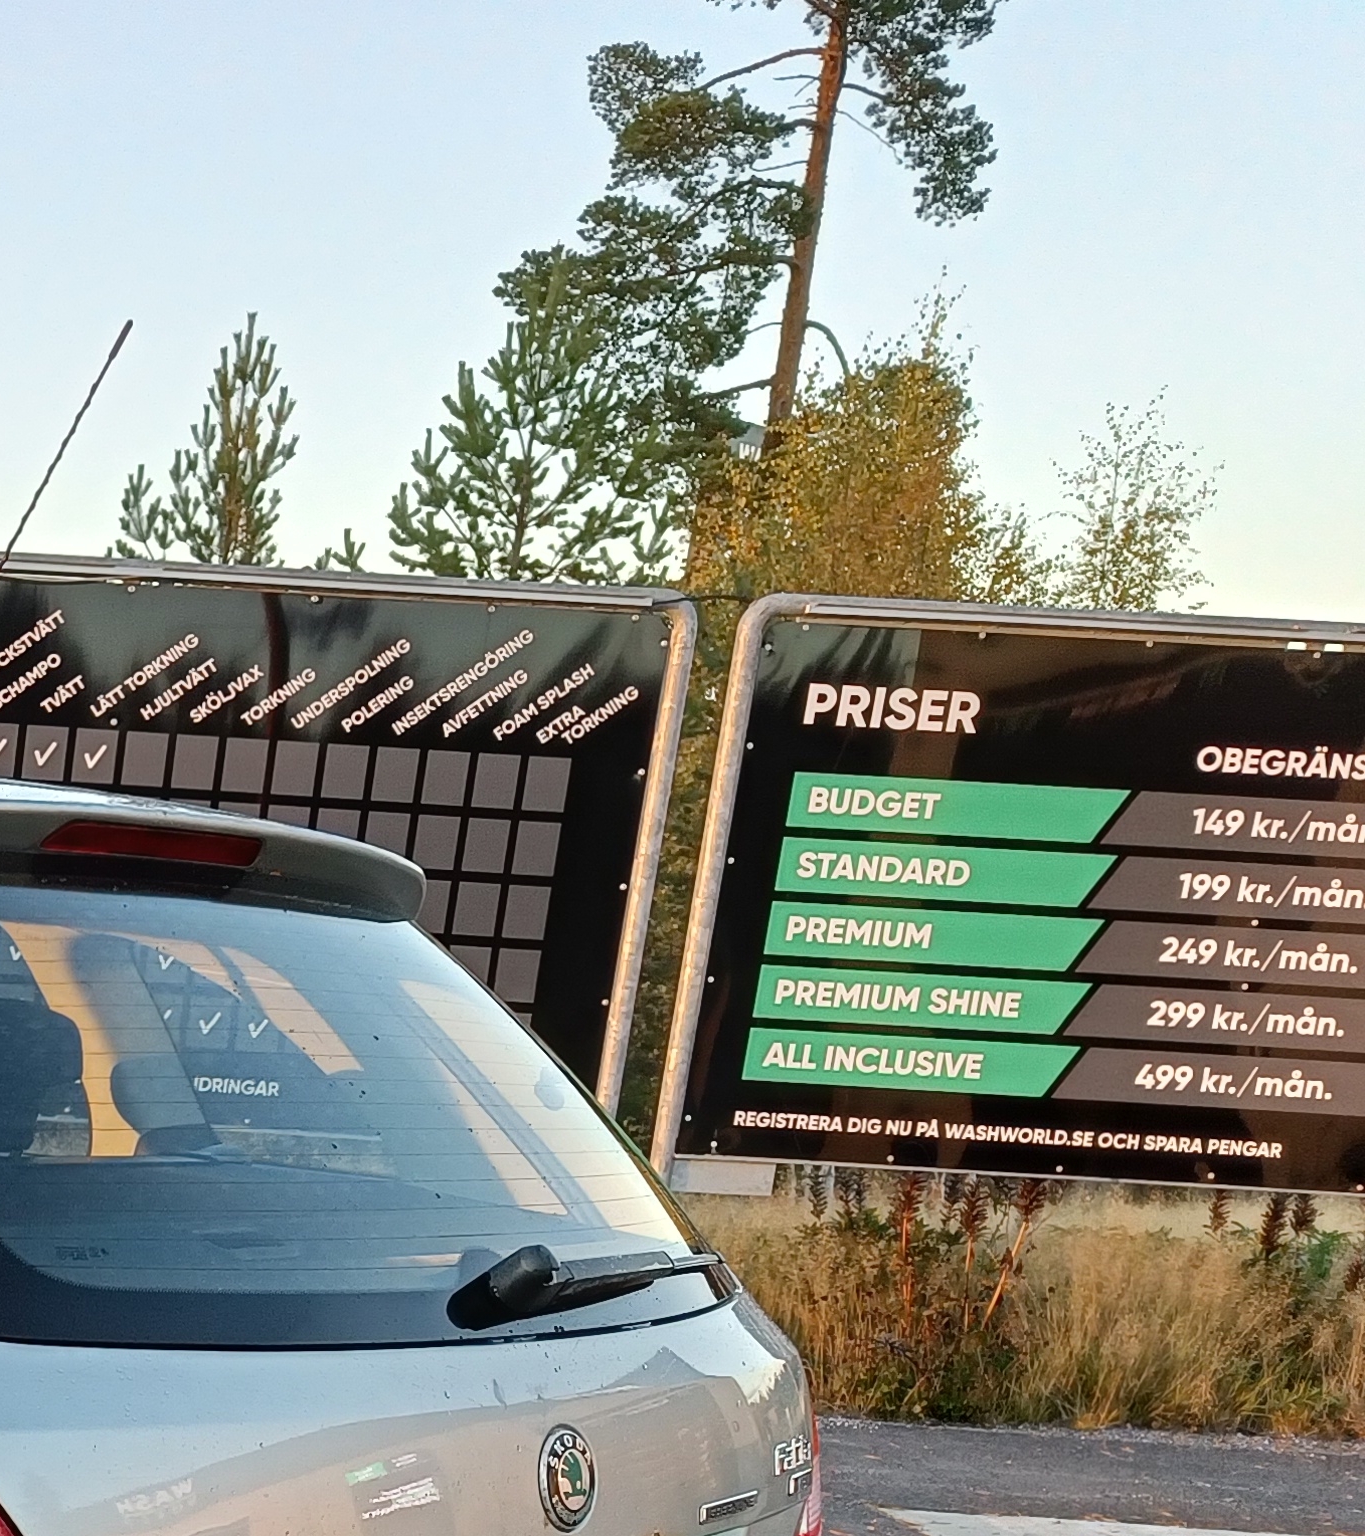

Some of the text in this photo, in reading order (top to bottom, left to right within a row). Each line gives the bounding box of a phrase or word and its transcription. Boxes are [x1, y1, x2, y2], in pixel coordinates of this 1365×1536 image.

[39, 675, 86, 713] TVÄTT
[89, 633, 200, 718] LÄTT TORKNING
[140, 657, 219, 721] HJULTVÄTT
[189, 664, 265, 723] SKÖLJVAX
[240, 668, 316, 727] TORKNING
[290, 638, 412, 730] UNDERSPOLNING
[391, 629, 534, 736] INSEKTSRENGÖRING
[341, 675, 415, 733] POLERING
[441, 669, 529, 738] AVFETTNING
[492, 663, 596, 741] FOAM SPLASH
[560, 685, 640, 745] TORKNING
[802, 682, 981, 734] PRISER
[536, 705, 586, 745] EXTRA
[807, 786, 942, 820] BUDGET
[1193, 808, 1245, 836] 149
[796, 852, 970, 886] STANDARD
[1179, 873, 1365, 909] 199 kr./mån
[785, 915, 933, 949] PREMIUM
[1159, 936, 1358, 974] 249 kr./mån.
[774, 979, 1022, 1019] PREMIUM SHINE
[1146, 1000, 1344, 1038] 299 kr./mån.
[762, 1042, 984, 1079] ALL INCLUSIVE
[1134, 1064, 1332, 1100] 499 kr./mån.
[733, 1110, 1283, 1159] REGISTRERA DIG NU PÅ WASHWORLD.SE OCH SPARA PENGAR
